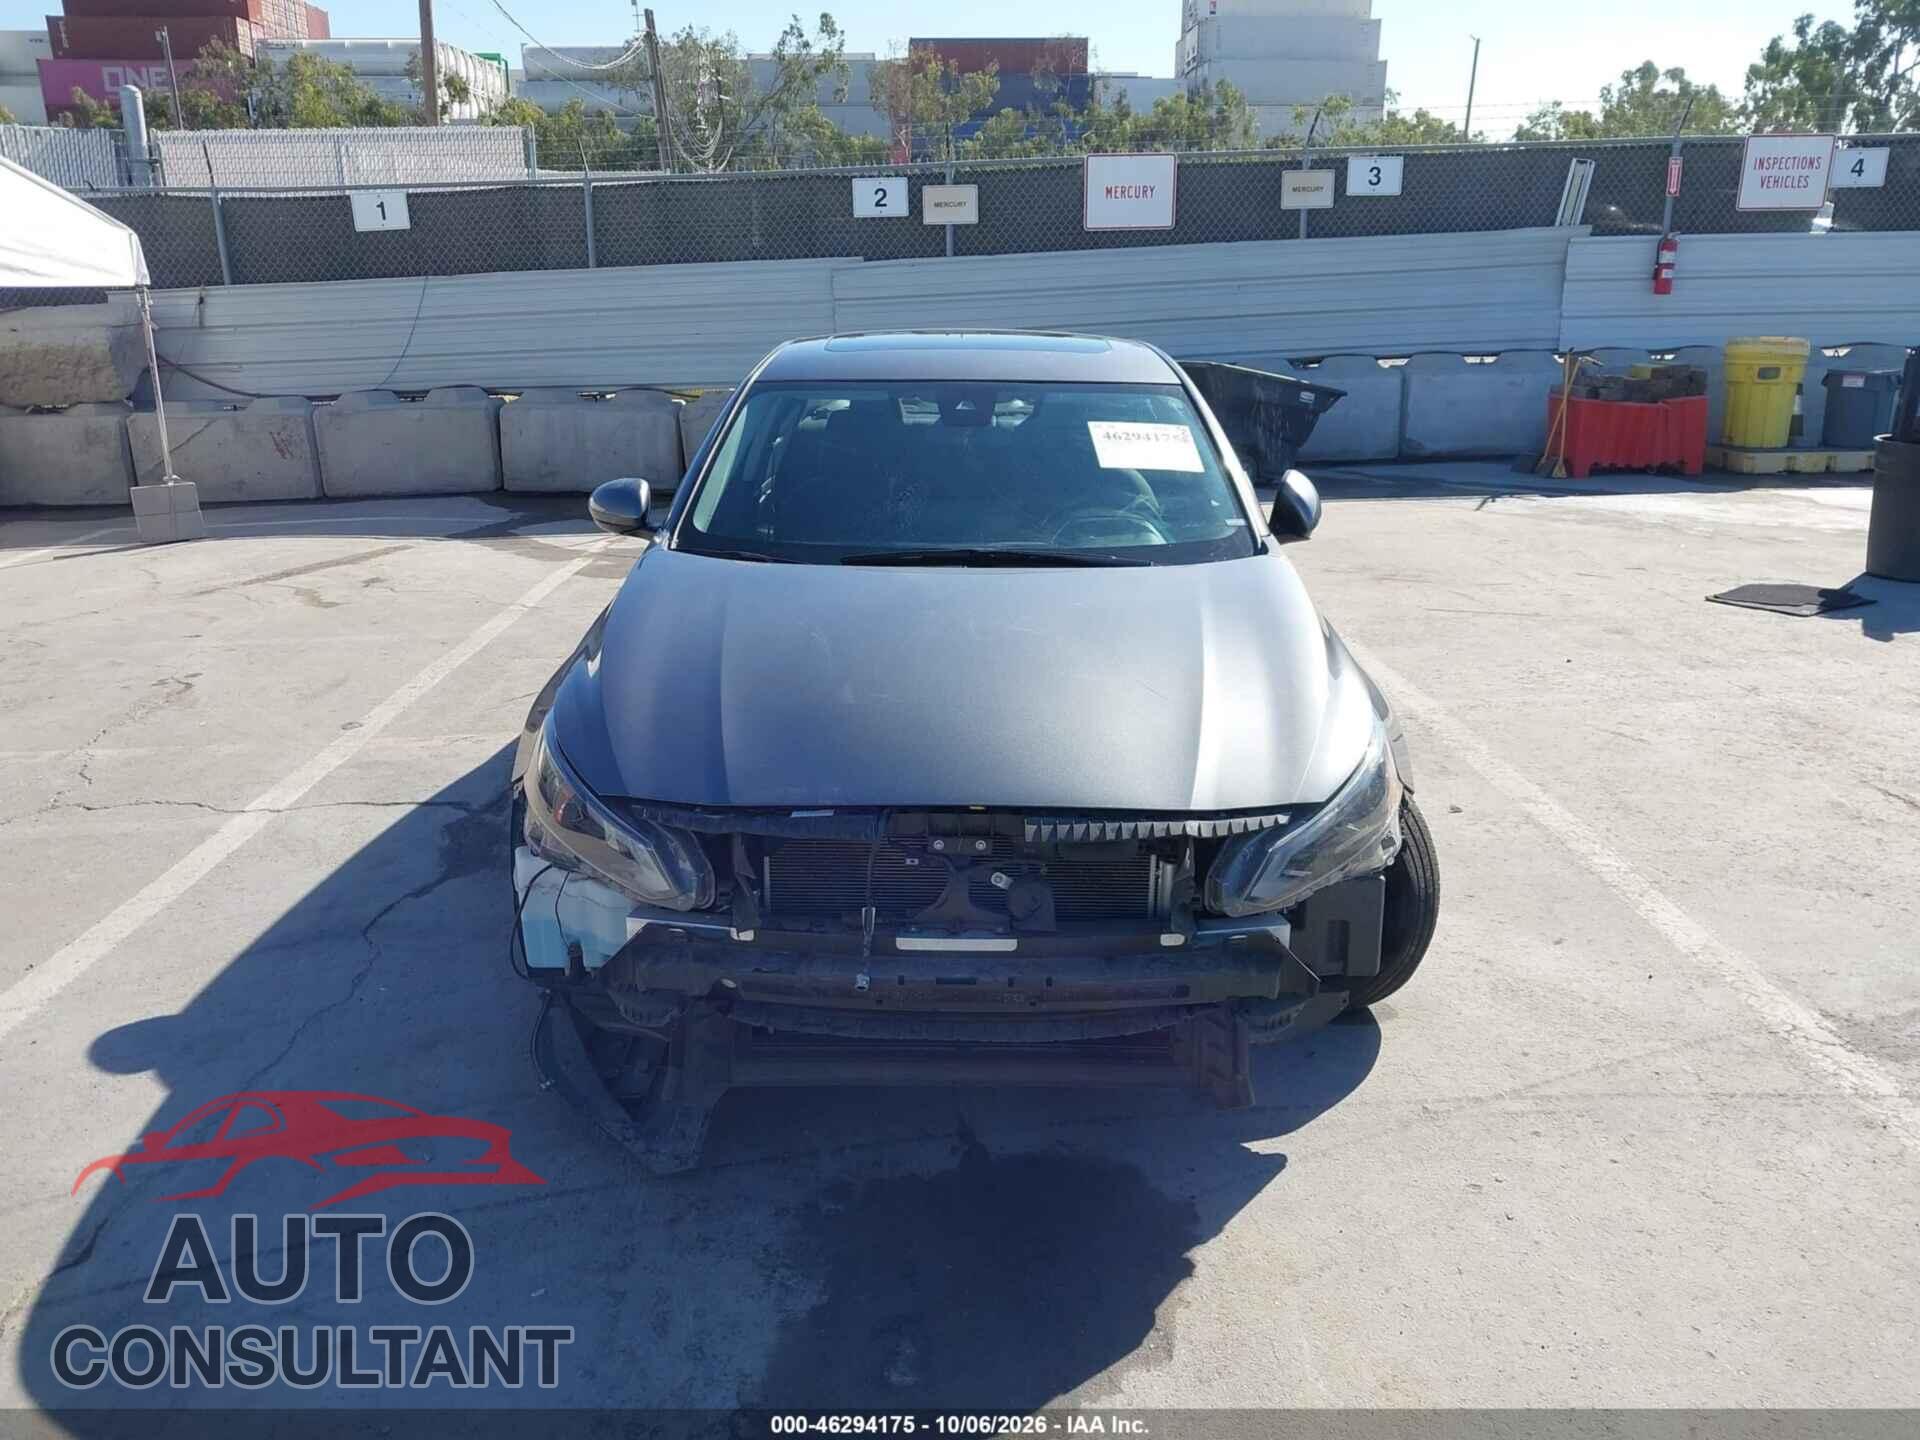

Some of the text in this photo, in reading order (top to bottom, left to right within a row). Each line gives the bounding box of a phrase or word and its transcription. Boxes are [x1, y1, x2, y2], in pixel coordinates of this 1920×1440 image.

[102, 66, 169, 92] ONE
[1753, 156, 1822, 171] INSPECTIONS
[1851, 158, 1865, 177] 4
[1368, 166, 1382, 186] 3
[1760, 175, 1809, 189] VEHICLES
[874, 188, 888, 207] 2
[1105, 185, 1156, 199] MERCURY
[1292, 185, 1324, 194] MERCURY
[376, 201, 386, 220] 1
[933, 200, 967, 209] MERCURY
